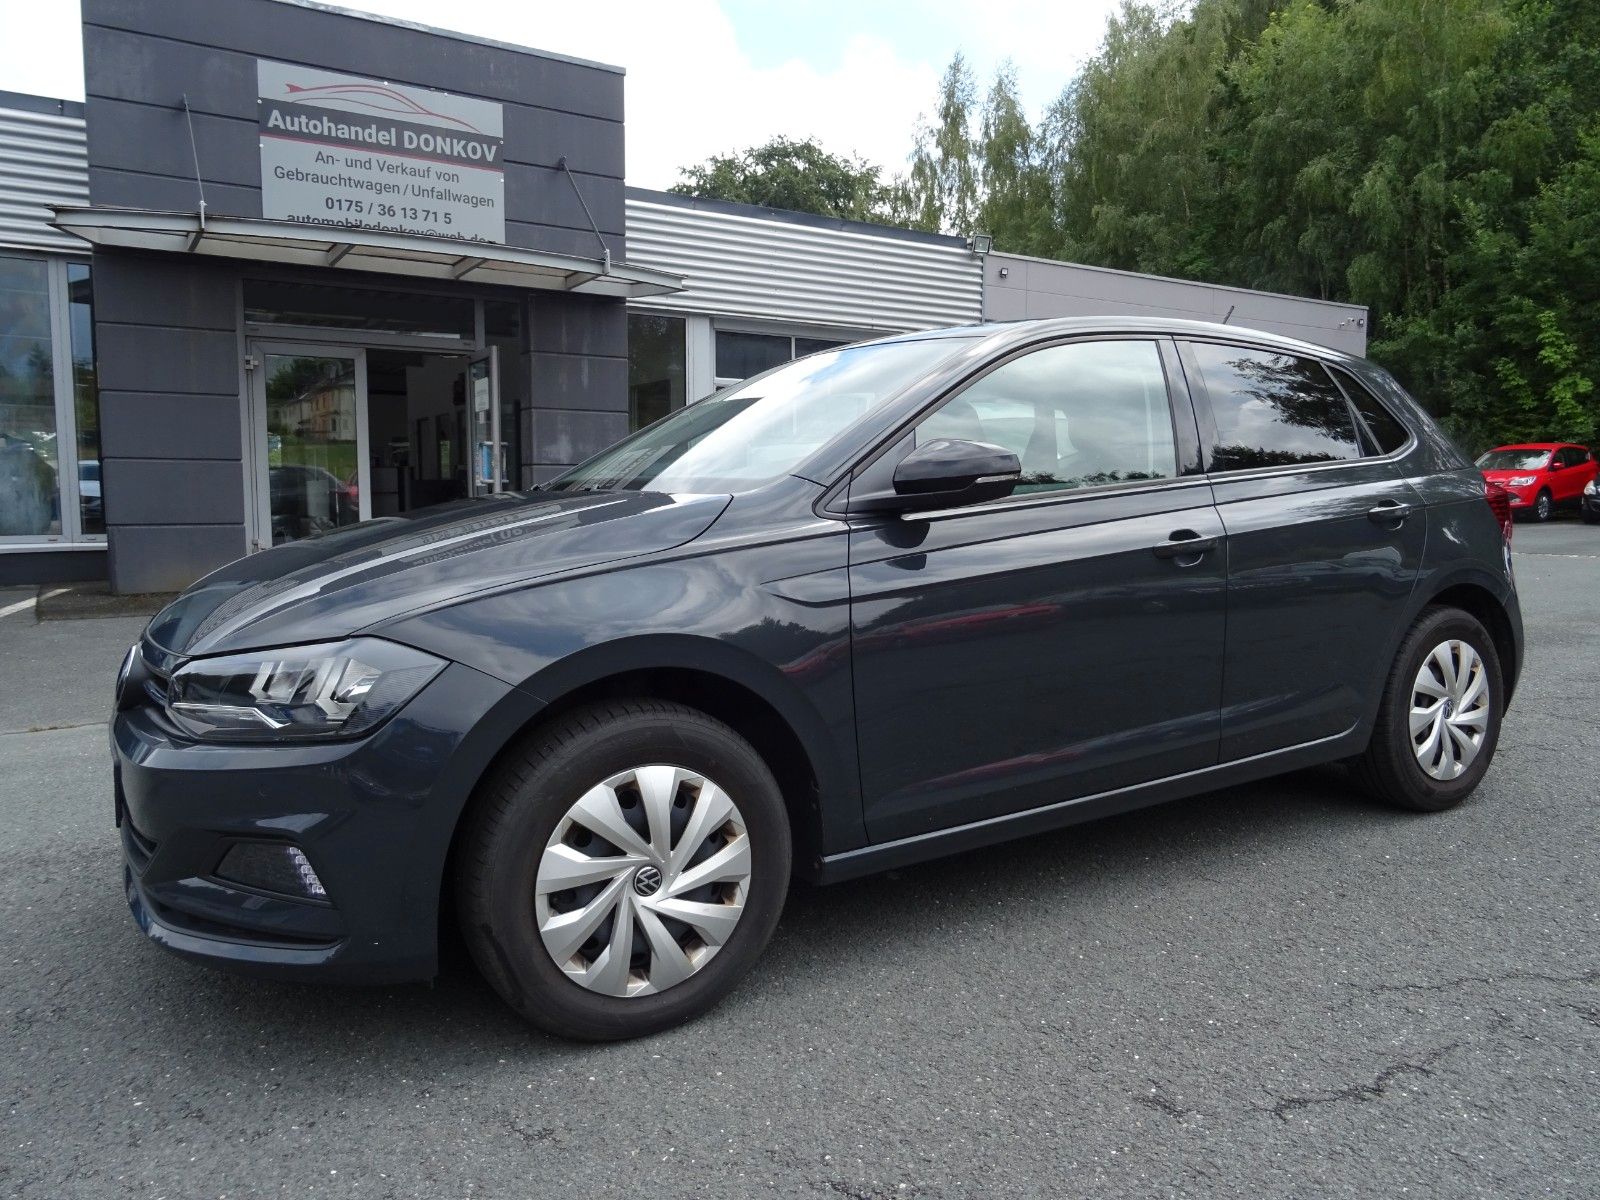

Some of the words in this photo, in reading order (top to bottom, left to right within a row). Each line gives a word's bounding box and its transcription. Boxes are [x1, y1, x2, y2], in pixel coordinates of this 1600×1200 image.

[267, 109, 397, 147] Autohandel
[403, 130, 497, 162] DONKOV
[315, 150, 340, 166] An-
[345, 155, 372, 171] und
[376, 159, 432, 179] Verkauf
[435, 169, 460, 183] von
[274, 166, 400, 197] Gebrauchtwagen
[411, 184, 495, 210] Unfallwagen
[325, 196, 363, 213] 0175
[377, 203, 396, 218] 36
[400, 207, 418, 221] 13
[422, 209, 438, 223] 71
[443, 212, 452, 225] 5
